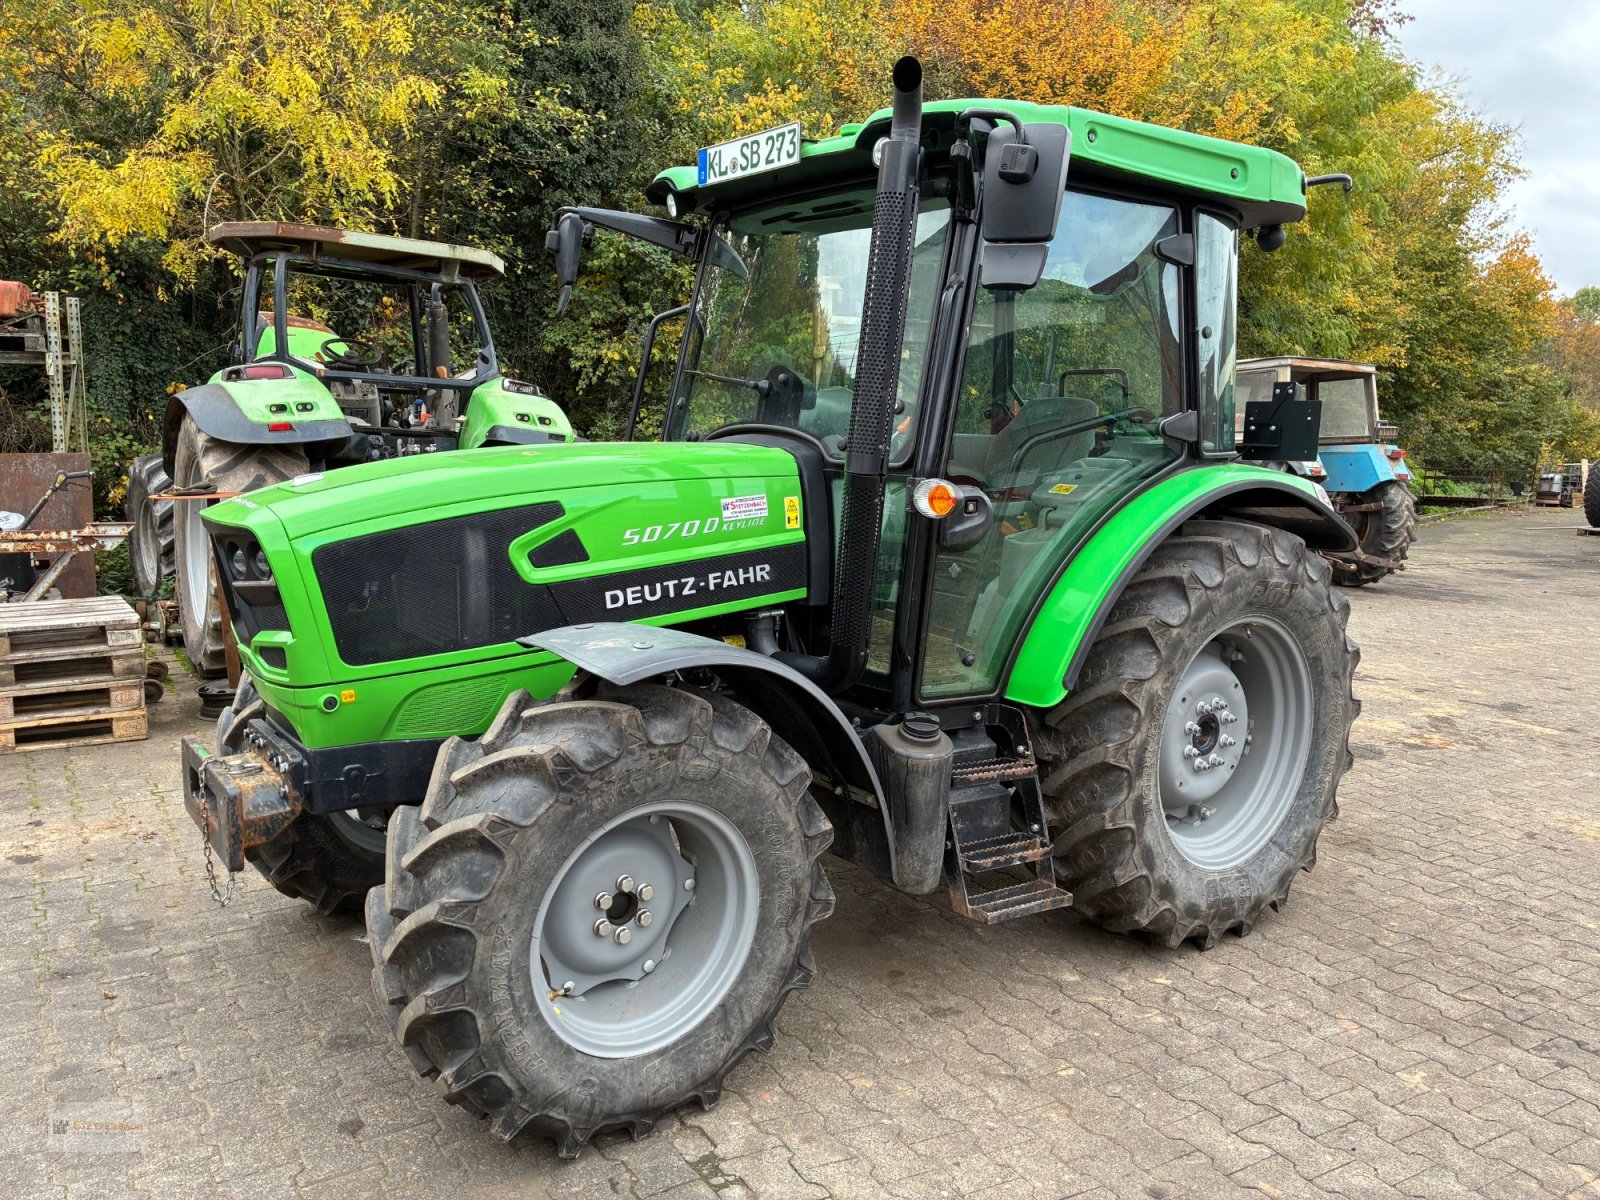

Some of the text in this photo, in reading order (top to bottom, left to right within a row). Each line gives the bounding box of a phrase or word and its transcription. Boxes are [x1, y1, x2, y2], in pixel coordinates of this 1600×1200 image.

[707, 149, 729, 180] KL
[739, 139, 761, 172] SB
[765, 128, 797, 165] 273
[604, 563, 771, 610] DEUTZ-FAHR
